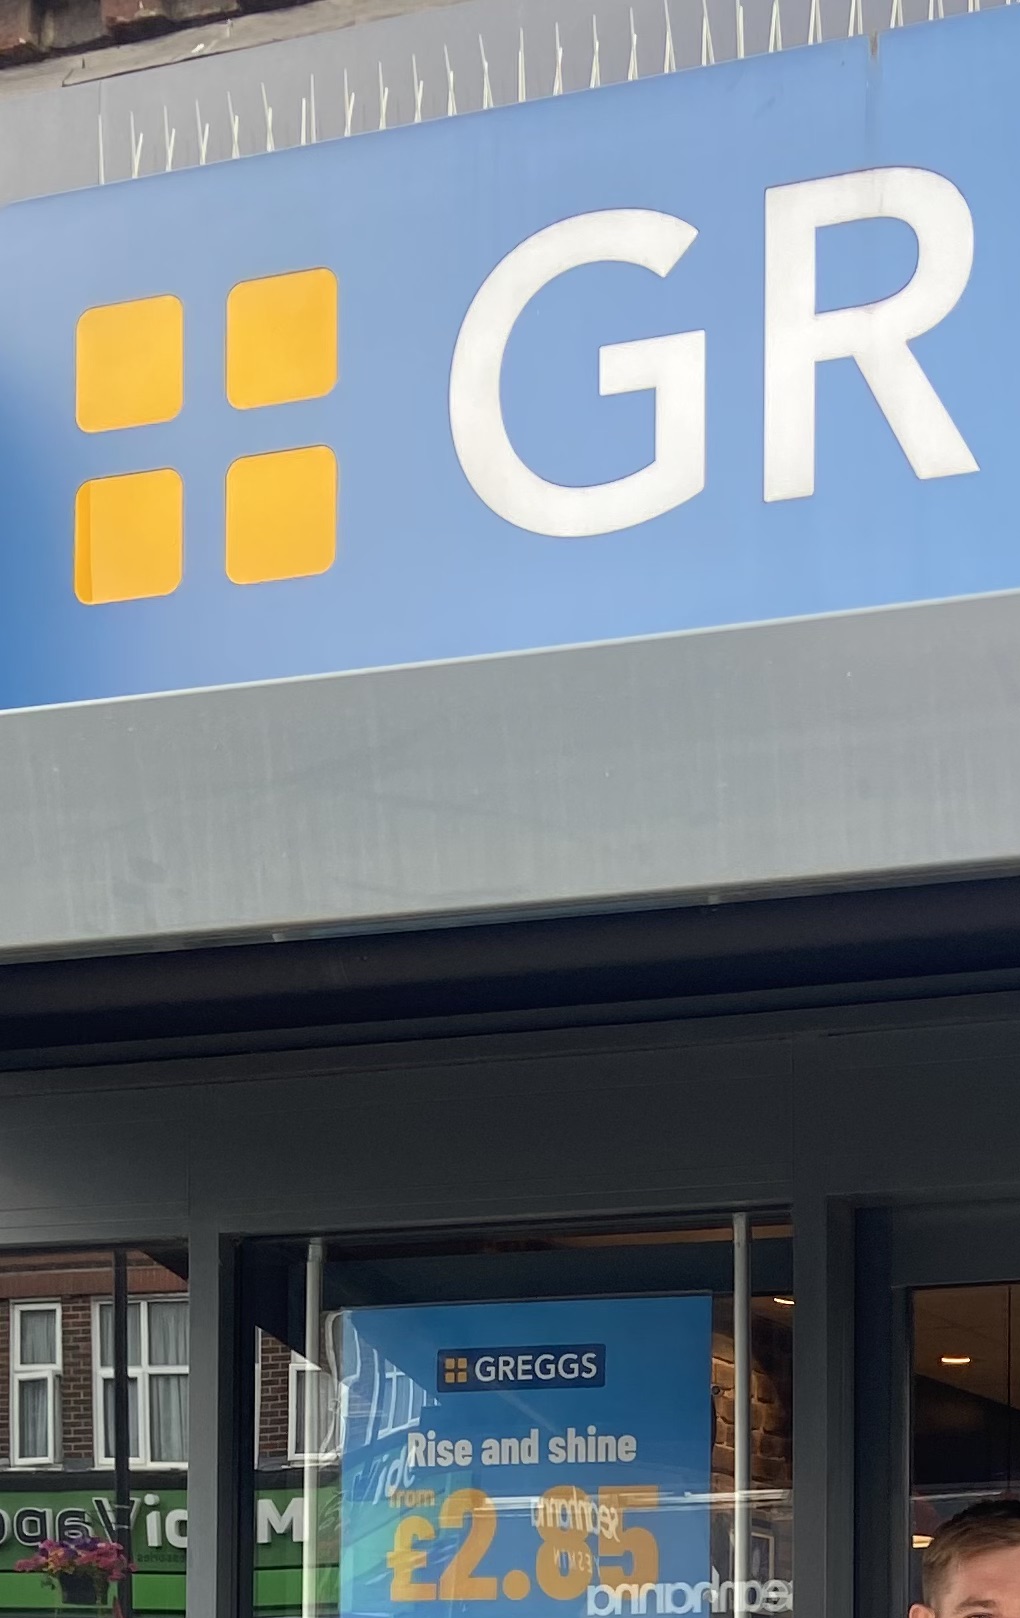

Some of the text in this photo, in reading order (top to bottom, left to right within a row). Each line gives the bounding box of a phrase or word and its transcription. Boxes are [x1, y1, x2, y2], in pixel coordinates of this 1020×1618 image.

[475, 1353, 597, 1382] GREGGS
[408, 1425, 637, 1467] Rise and shine
[388, 1487, 435, 1508] from
[387, 1485, 659, 1602] £2.85
